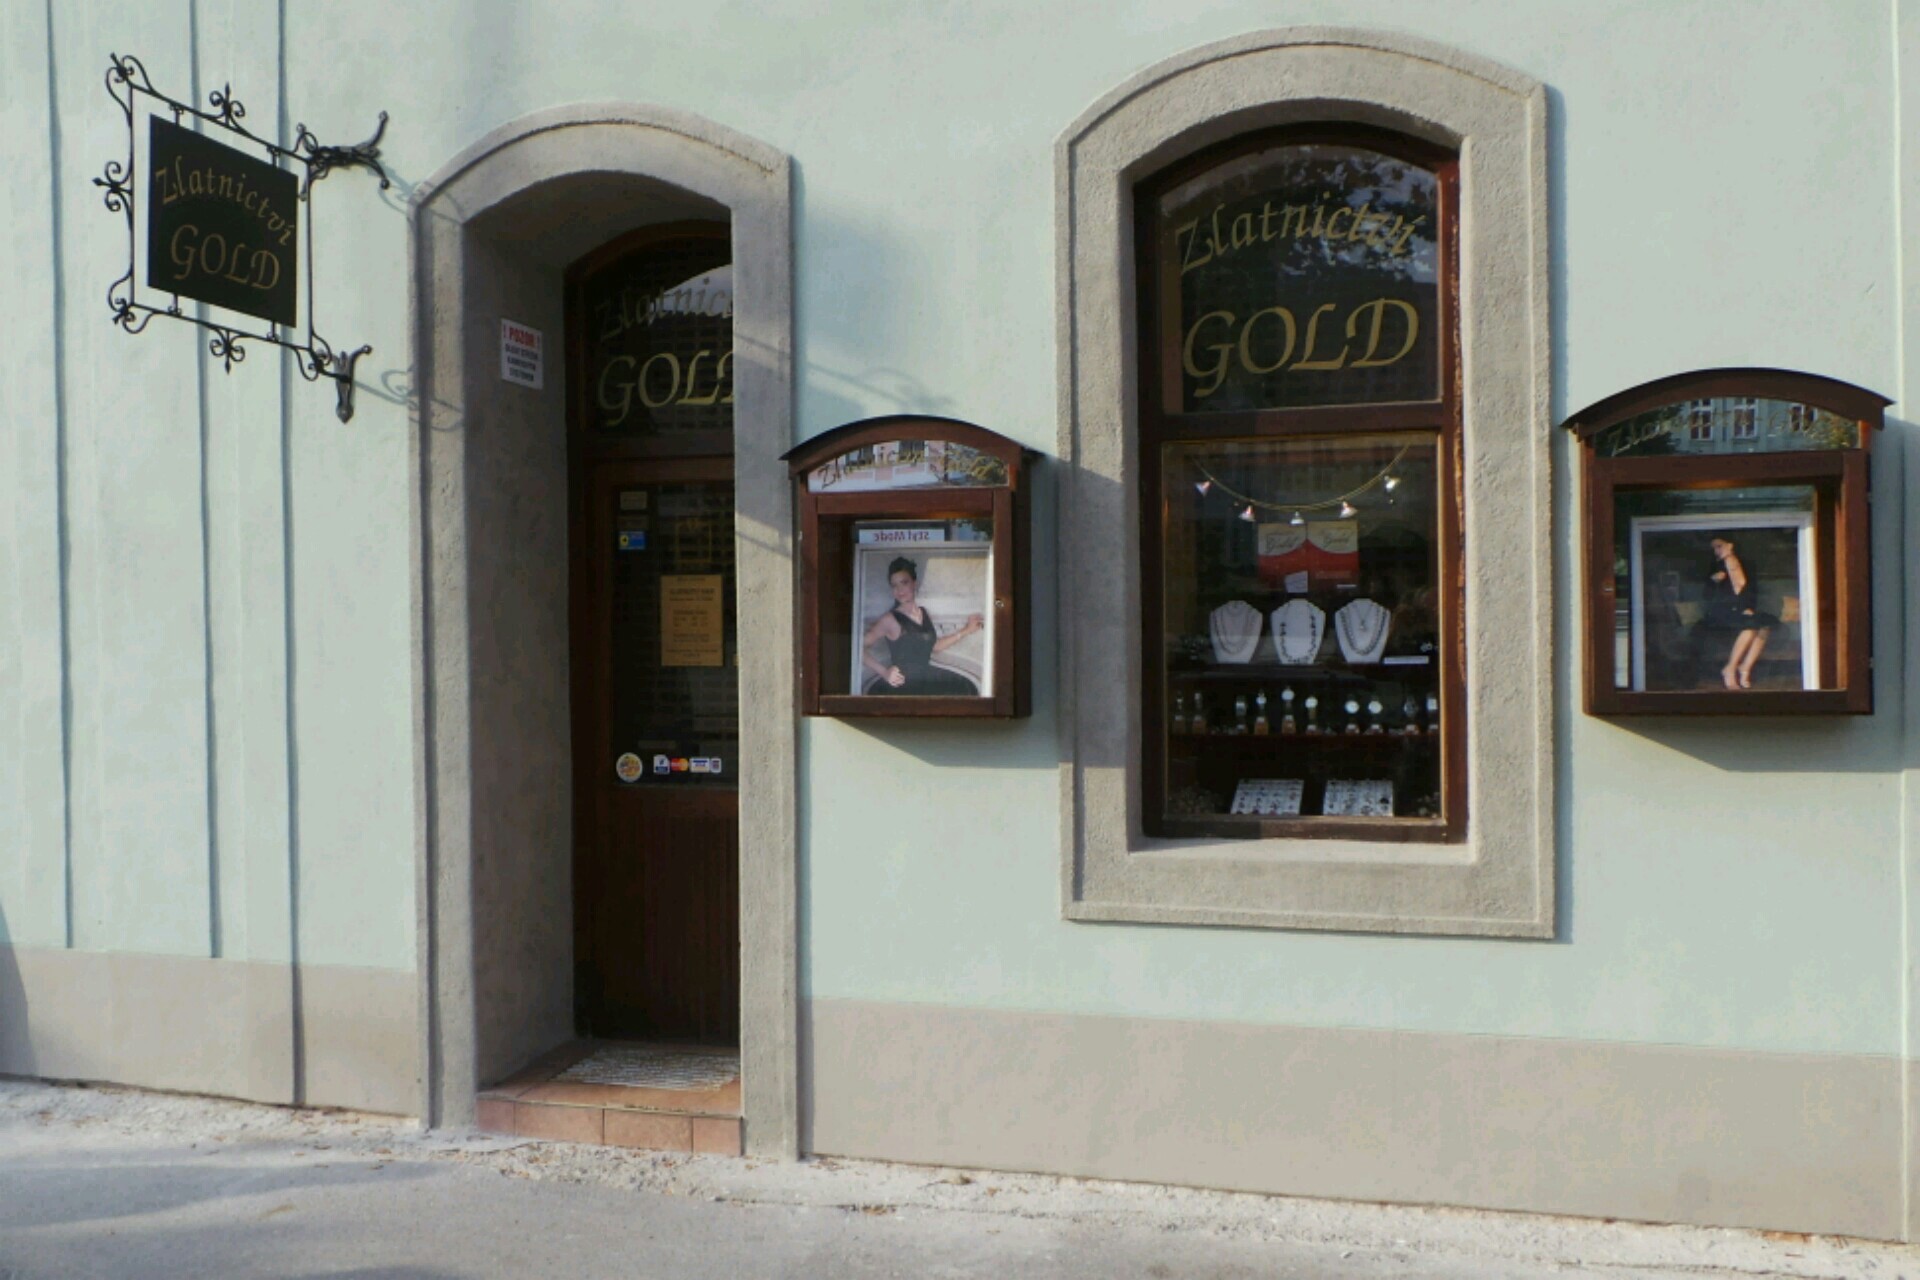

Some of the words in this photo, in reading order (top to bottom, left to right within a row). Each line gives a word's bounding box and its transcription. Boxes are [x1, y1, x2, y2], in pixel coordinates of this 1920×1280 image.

[155, 154, 295, 246] Zlatnictví
[1174, 190, 1426, 276] Zlatnictví
[170, 223, 281, 290] GOLD
[1183, 297, 1420, 398] GOLD
